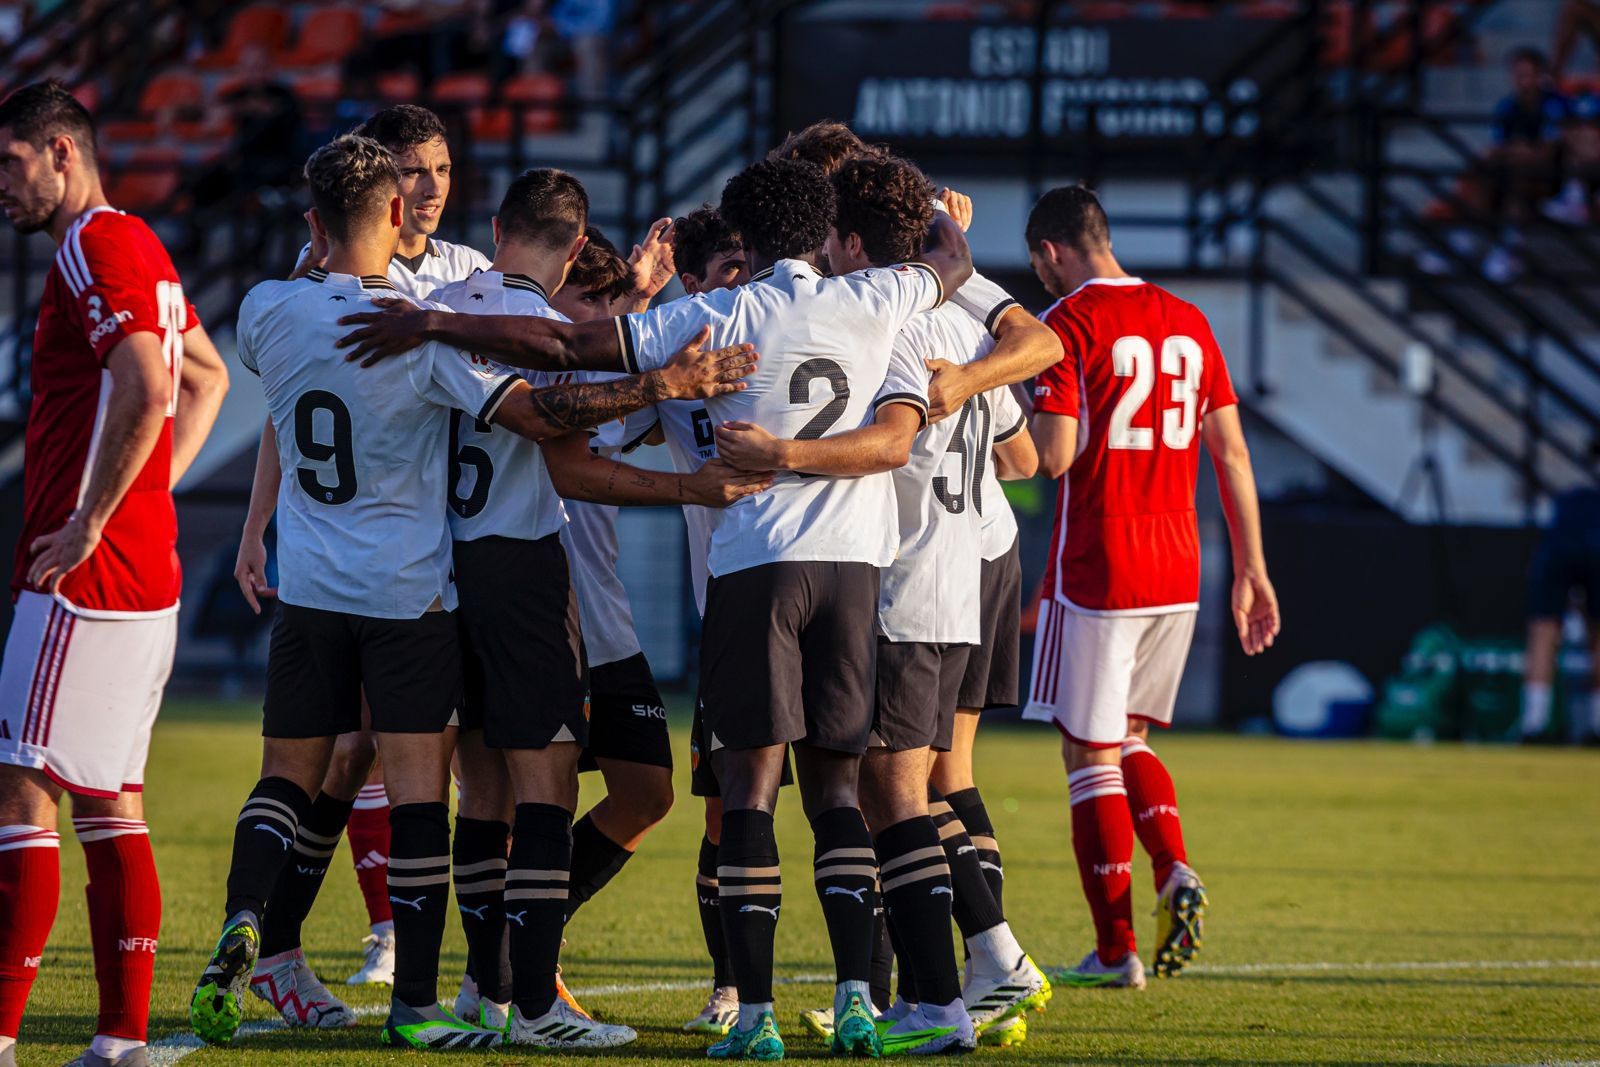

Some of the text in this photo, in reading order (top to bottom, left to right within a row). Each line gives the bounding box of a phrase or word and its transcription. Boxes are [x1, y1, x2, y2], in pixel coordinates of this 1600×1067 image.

[294, 389, 358, 505] 9
[788, 357, 850, 478] 2
[1108, 335, 1204, 450] 23
[447, 407, 495, 519] 6
[118, 937, 158, 954] NFFC
